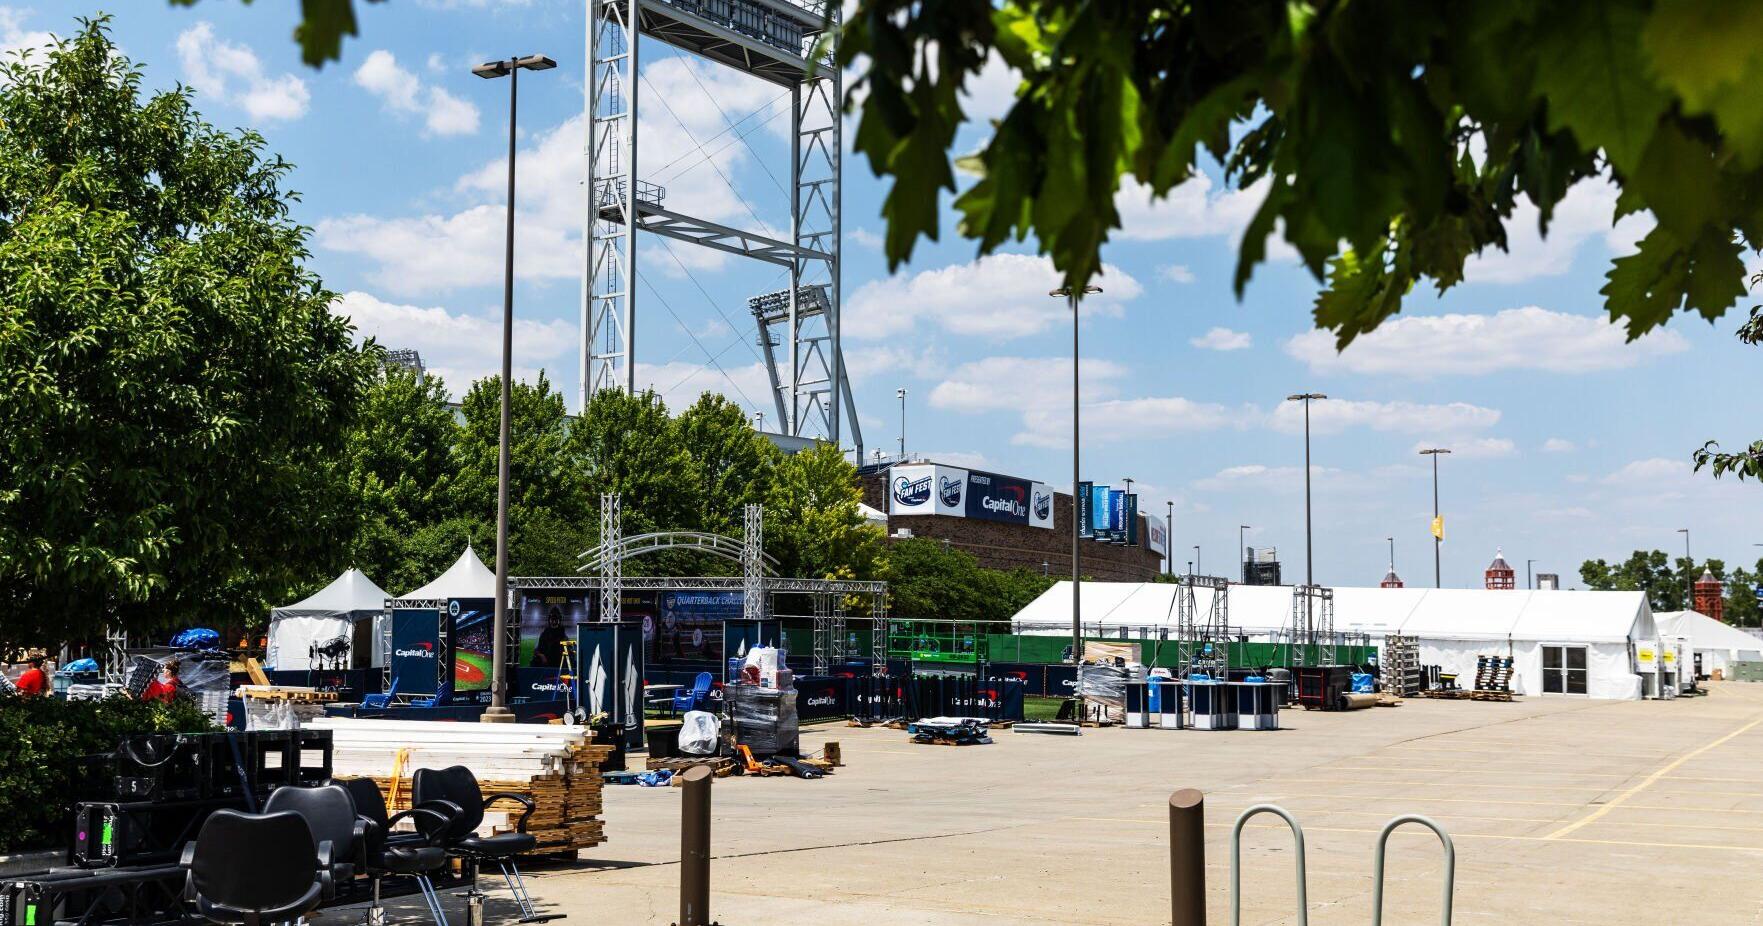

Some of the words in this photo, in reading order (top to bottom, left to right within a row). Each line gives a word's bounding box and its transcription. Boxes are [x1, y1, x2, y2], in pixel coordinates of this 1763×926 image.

[900, 486, 914, 499] FAN
[914, 480, 932, 494] FEST
[677, 596, 720, 606] QUARTERBACK
[131, 780, 136, 792] 5
